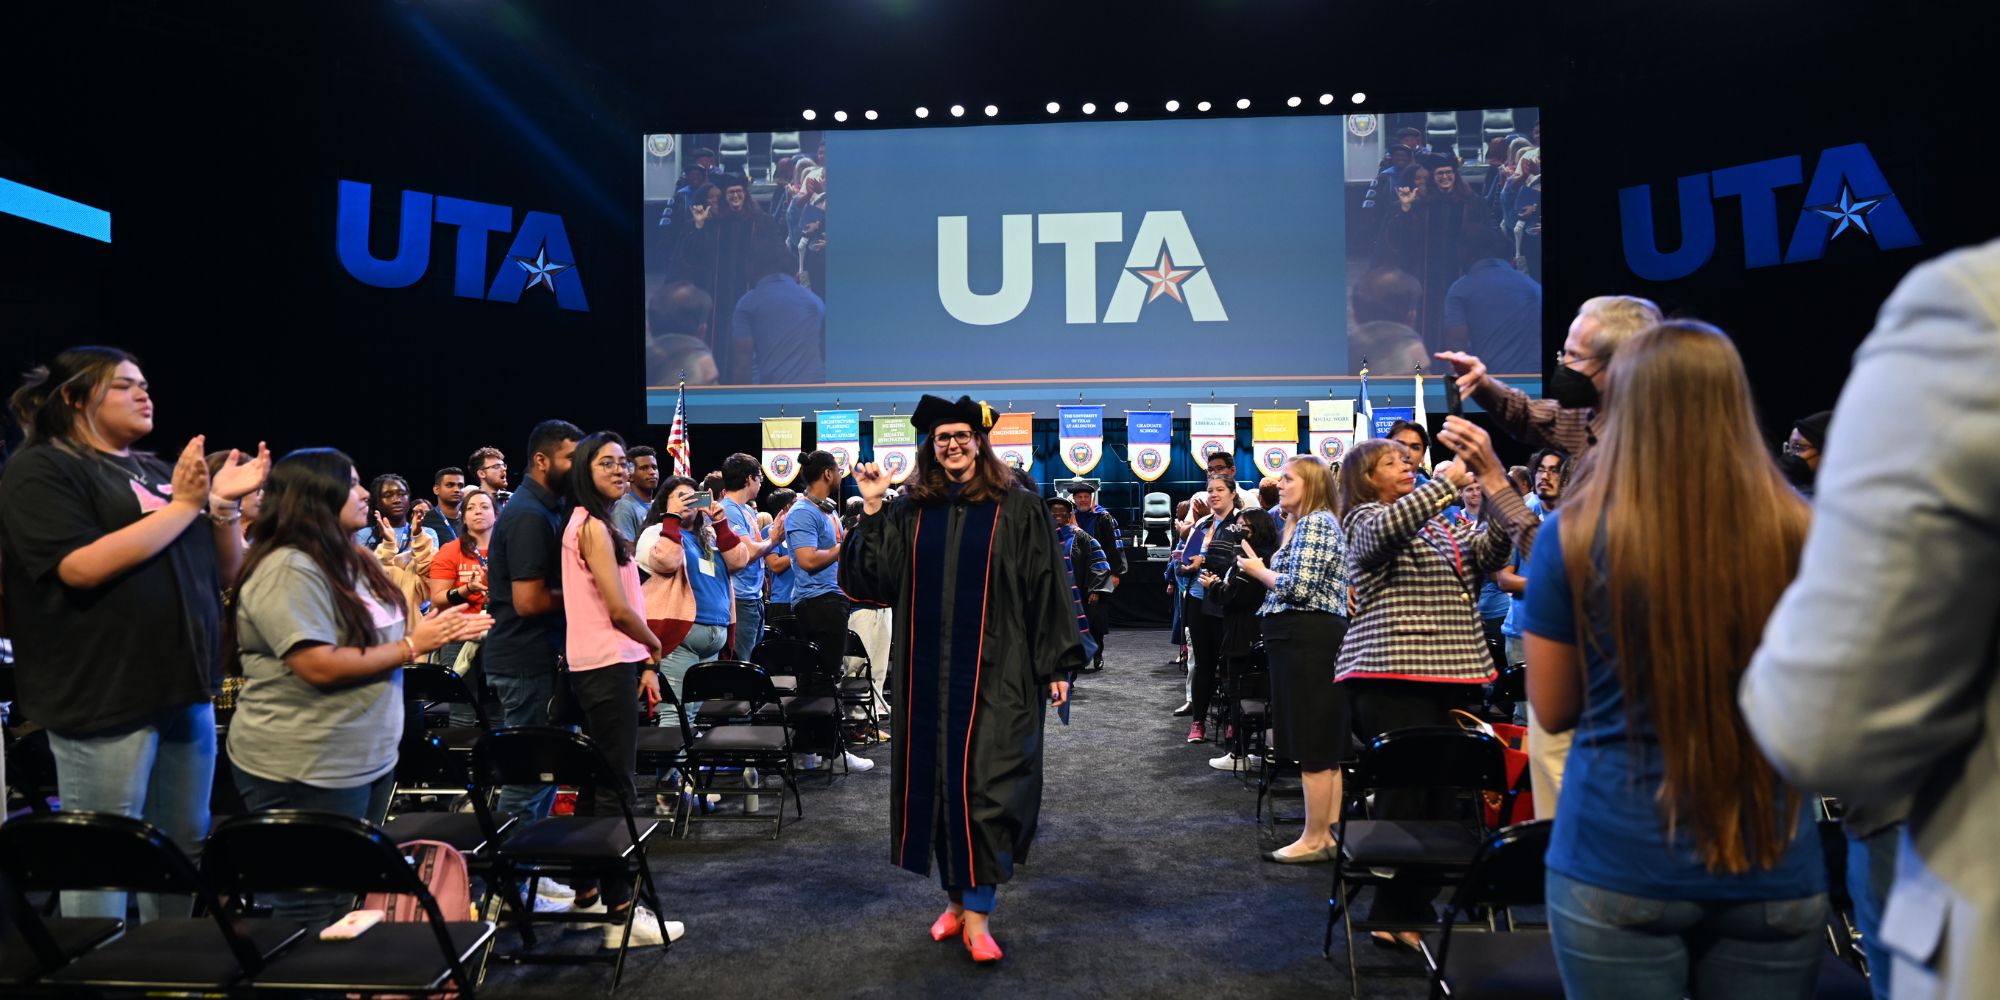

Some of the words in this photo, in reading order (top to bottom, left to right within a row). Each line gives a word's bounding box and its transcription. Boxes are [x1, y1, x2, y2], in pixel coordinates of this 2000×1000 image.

[336, 179, 590, 312] UTA
[937, 210, 1229, 325] UTA
[1619, 142, 1922, 281] UTA
